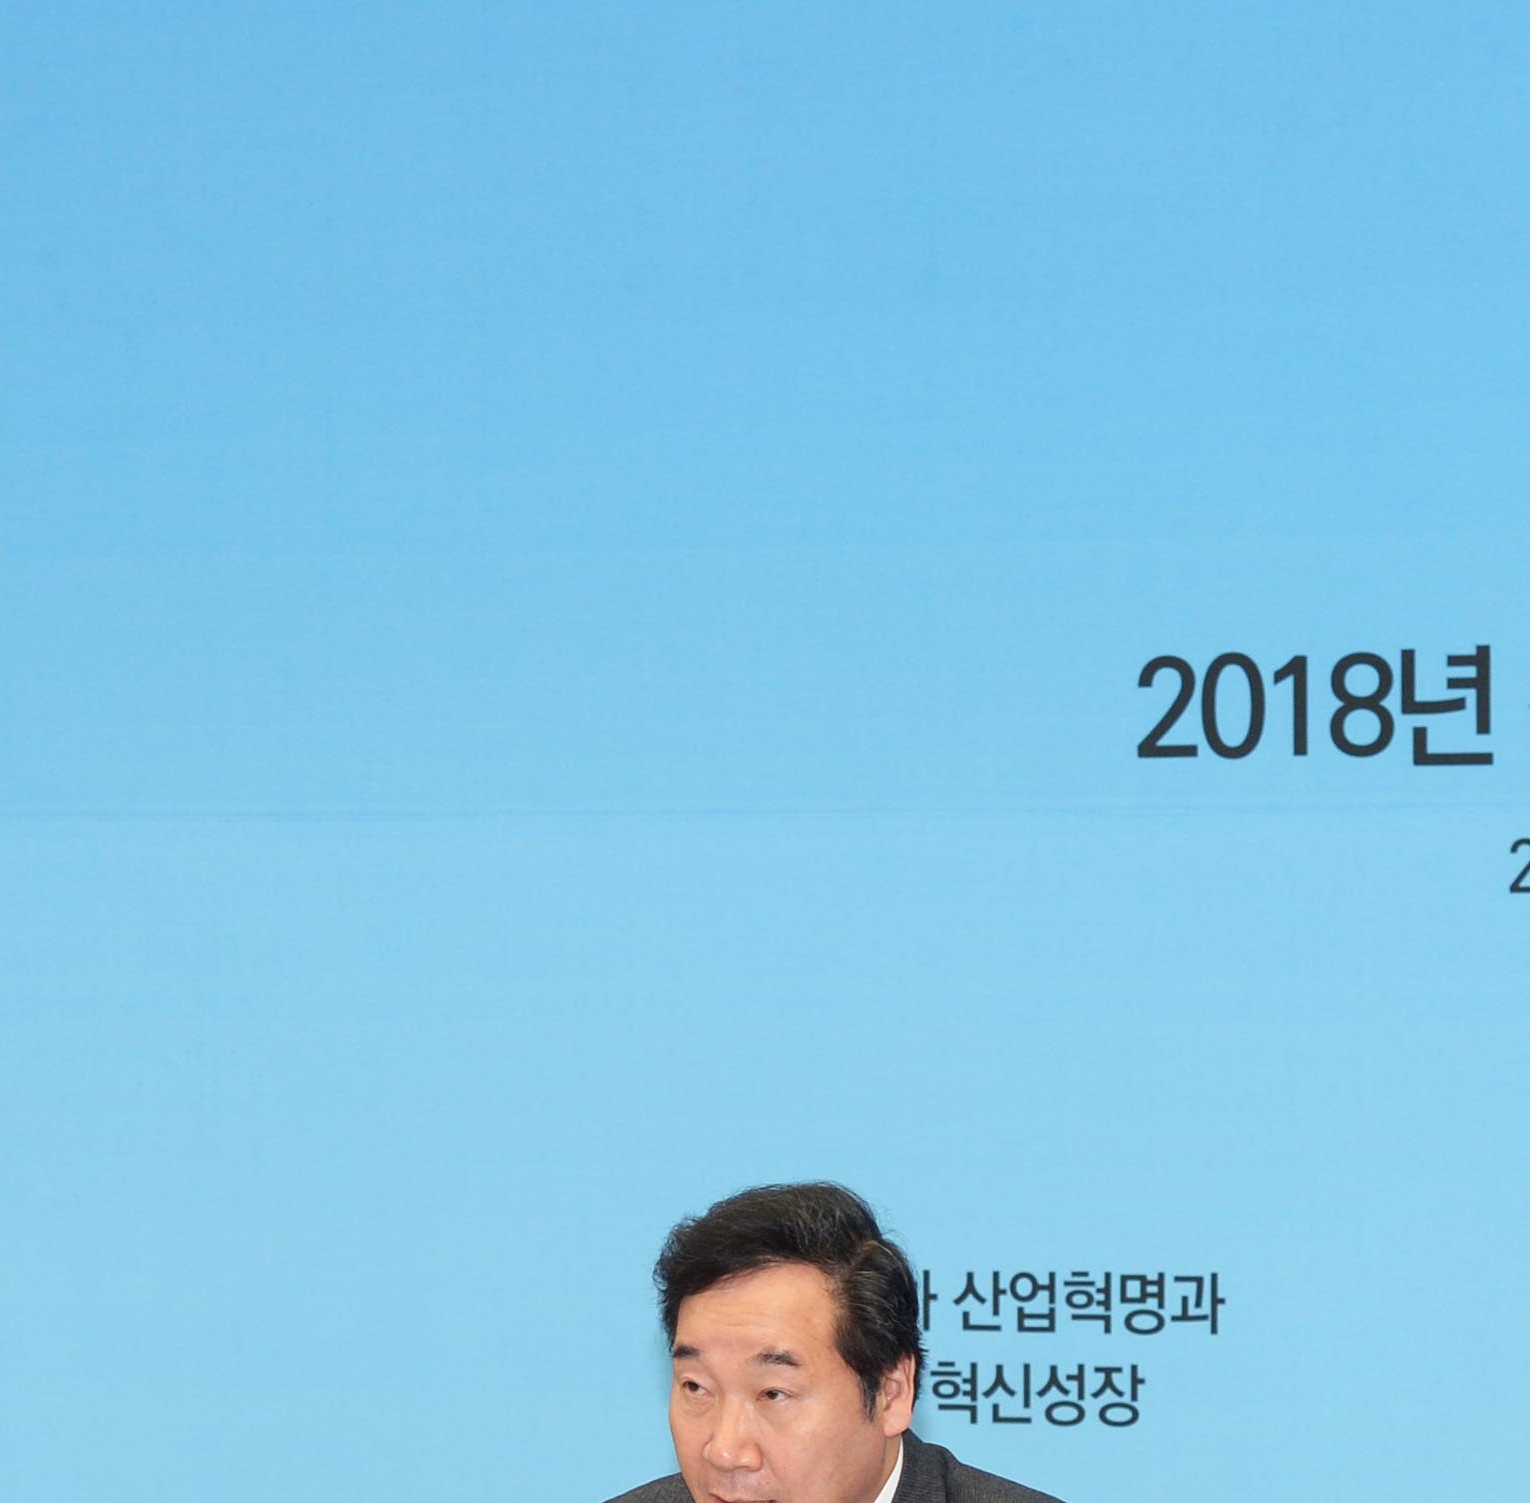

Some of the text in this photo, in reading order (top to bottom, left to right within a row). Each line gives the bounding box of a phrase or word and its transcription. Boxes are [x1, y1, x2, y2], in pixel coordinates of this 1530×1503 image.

[1136, 644, 1494, 767] 2018년
[952, 1270, 1226, 1335] 산업혁명과
[929, 1360, 1146, 1427] 혁신성장
